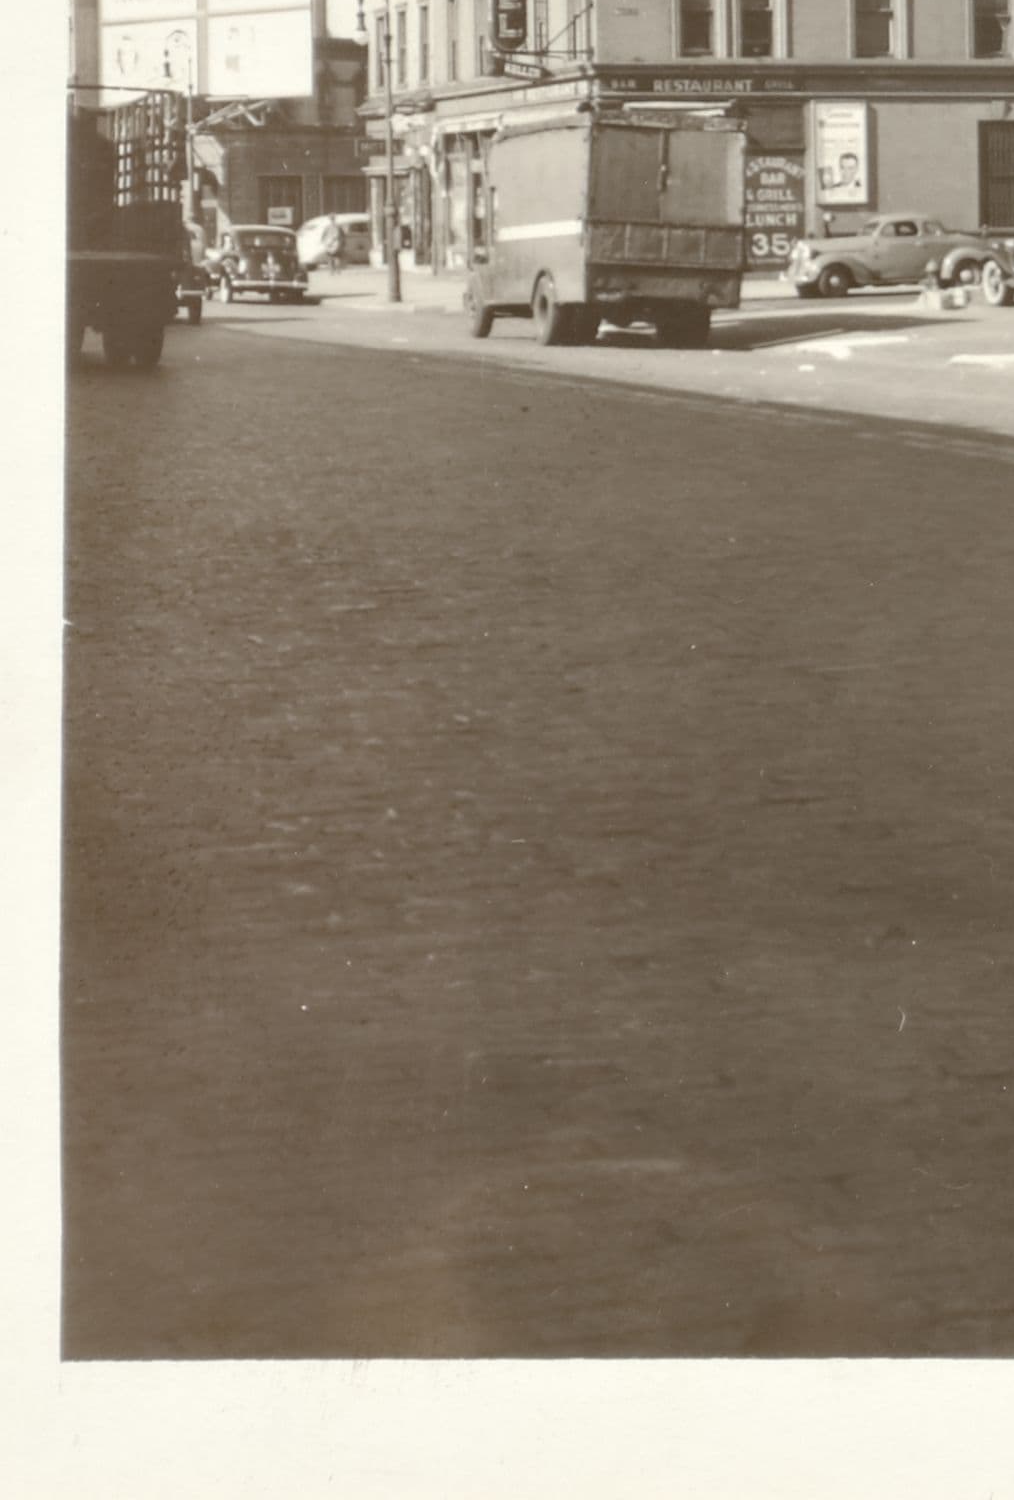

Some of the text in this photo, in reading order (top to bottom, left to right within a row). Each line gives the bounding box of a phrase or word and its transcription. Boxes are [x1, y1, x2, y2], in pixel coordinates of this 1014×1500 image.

[653, 79, 753, 93] RESTAURANT
[759, 172, 786, 185] BAR
[756, 188, 795, 201] GRILL
[745, 213, 797, 228] LUNCH
